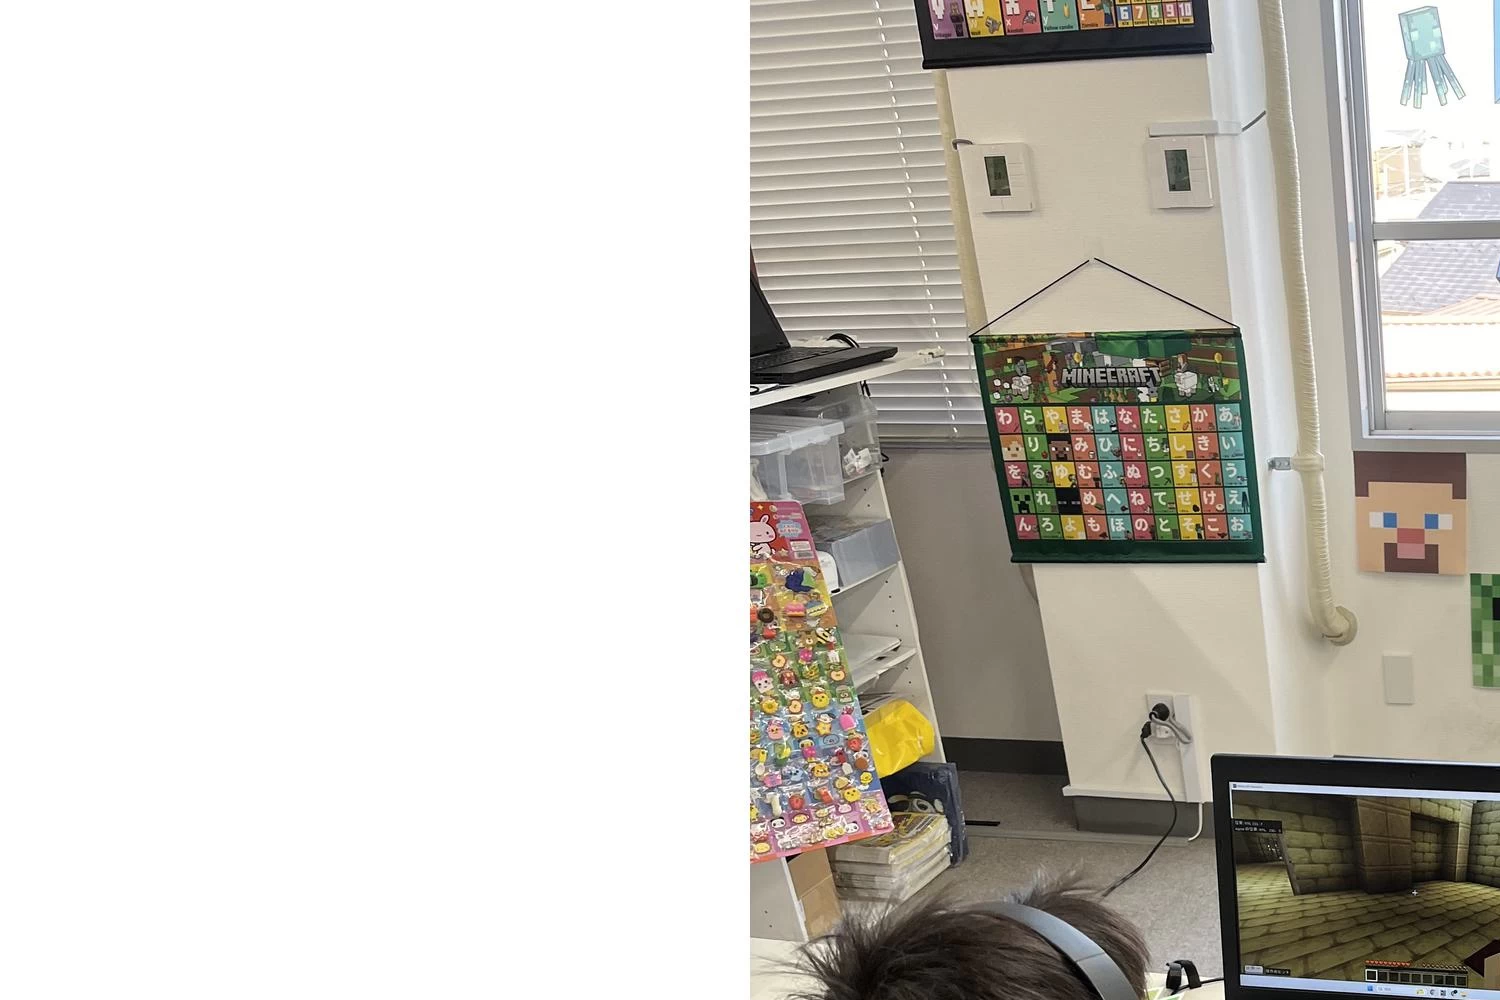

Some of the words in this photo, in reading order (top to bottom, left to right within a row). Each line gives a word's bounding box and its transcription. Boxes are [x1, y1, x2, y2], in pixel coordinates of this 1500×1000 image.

[1121, 7, 1129, 20] 6
[1135, 6, 1143, 19] 7
[1150, 5, 1160, 18] 8
[1165, 4, 1175, 17] 9
[1179, 3, 1192, 17] 10
[1061, 367, 1161, 387] MINECRAFT
[998, 409, 1013, 425] わ
[1023, 409, 1035, 425] ら
[1046, 409, 1059, 424] や
[1071, 409, 1084, 424] ま
[1094, 409, 1109, 424] は
[1118, 408, 1132, 423] な
[1142, 408, 1158, 424] た
[1169, 408, 1181, 423] さ
[1192, 407, 1208, 423] か
[1219, 407, 1233, 422] あ
[1028, 436, 1039, 452] り
[1074, 437, 1089, 452] み
[1099, 437, 1112, 452] ひ
[1123, 437, 1137, 452] に
[1146, 437, 1160, 452] ち
[1173, 436, 1185, 451] し
[1197, 435, 1210, 450] き
[1221, 436, 1236, 450] い
[1007, 464, 1021, 480] を
[1032, 464, 1045, 479] る
[1054, 464, 1068, 479] ゆ
[1078, 464, 1092, 479] む
[1103, 464, 1118, 479] ふ
[1126, 464, 1141, 479] ぬ
[1150, 466, 1164, 478] つ
[1175, 463, 1188, 479] す
[1201, 463, 1211, 478] く
[1225, 462, 1237, 478] う
[1035, 490, 1051, 506] れ
[1083, 491, 1097, 505] め
[1106, 492, 1121, 505] へ
[1130, 490, 1145, 505] ね
[1153, 492, 1167, 505] て
[1178, 490, 1191, 505] せ
[1202, 490, 1217, 505] け
[1228, 490, 1242, 505] え
[1018, 517, 1032, 531] ん
[1041, 517, 1054, 532] ろ
[1065, 517, 1077, 532] よ
[1087, 517, 1100, 532] も
[1110, 517, 1125, 531] ほ
[1134, 518, 1148, 531] の
[1158, 517, 1170, 531] と
[1182, 517, 1195, 531] そ
[1207, 518, 1220, 531] こ
[1230, 516, 1244, 531] お
